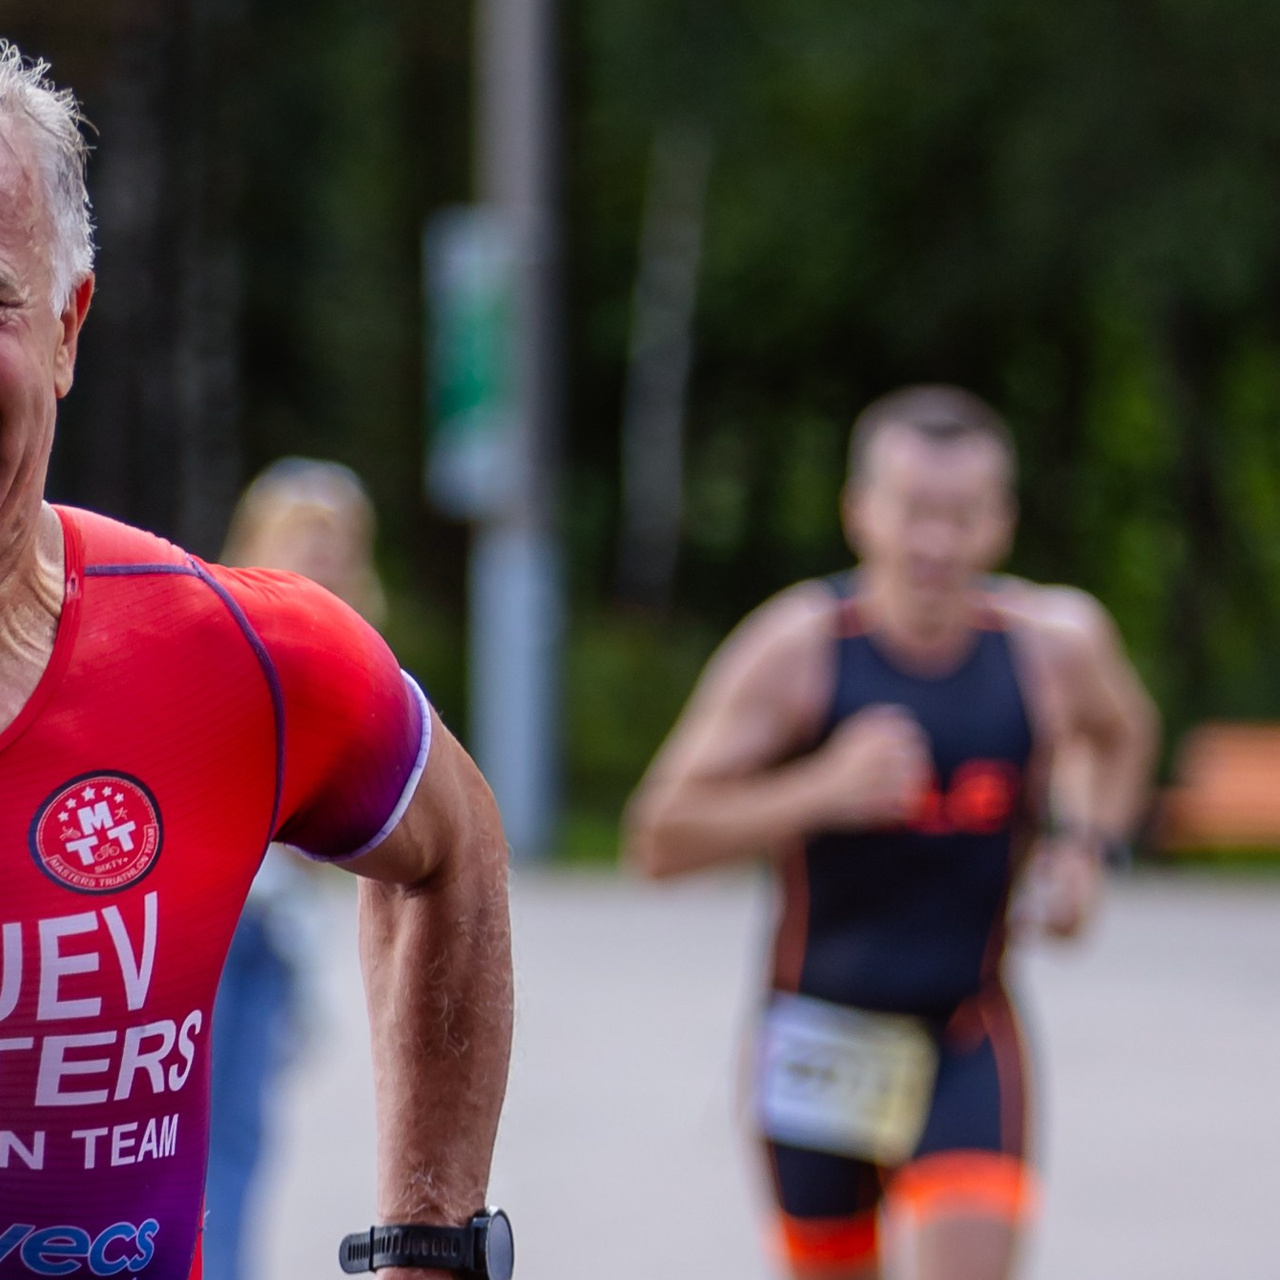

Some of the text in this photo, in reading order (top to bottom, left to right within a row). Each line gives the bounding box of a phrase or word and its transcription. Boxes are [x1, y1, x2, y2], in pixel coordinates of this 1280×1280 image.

[49, 827, 156, 887] MASTERS TRIATHLON TEAM
[72, 1114, 179, 1170] TEAM
